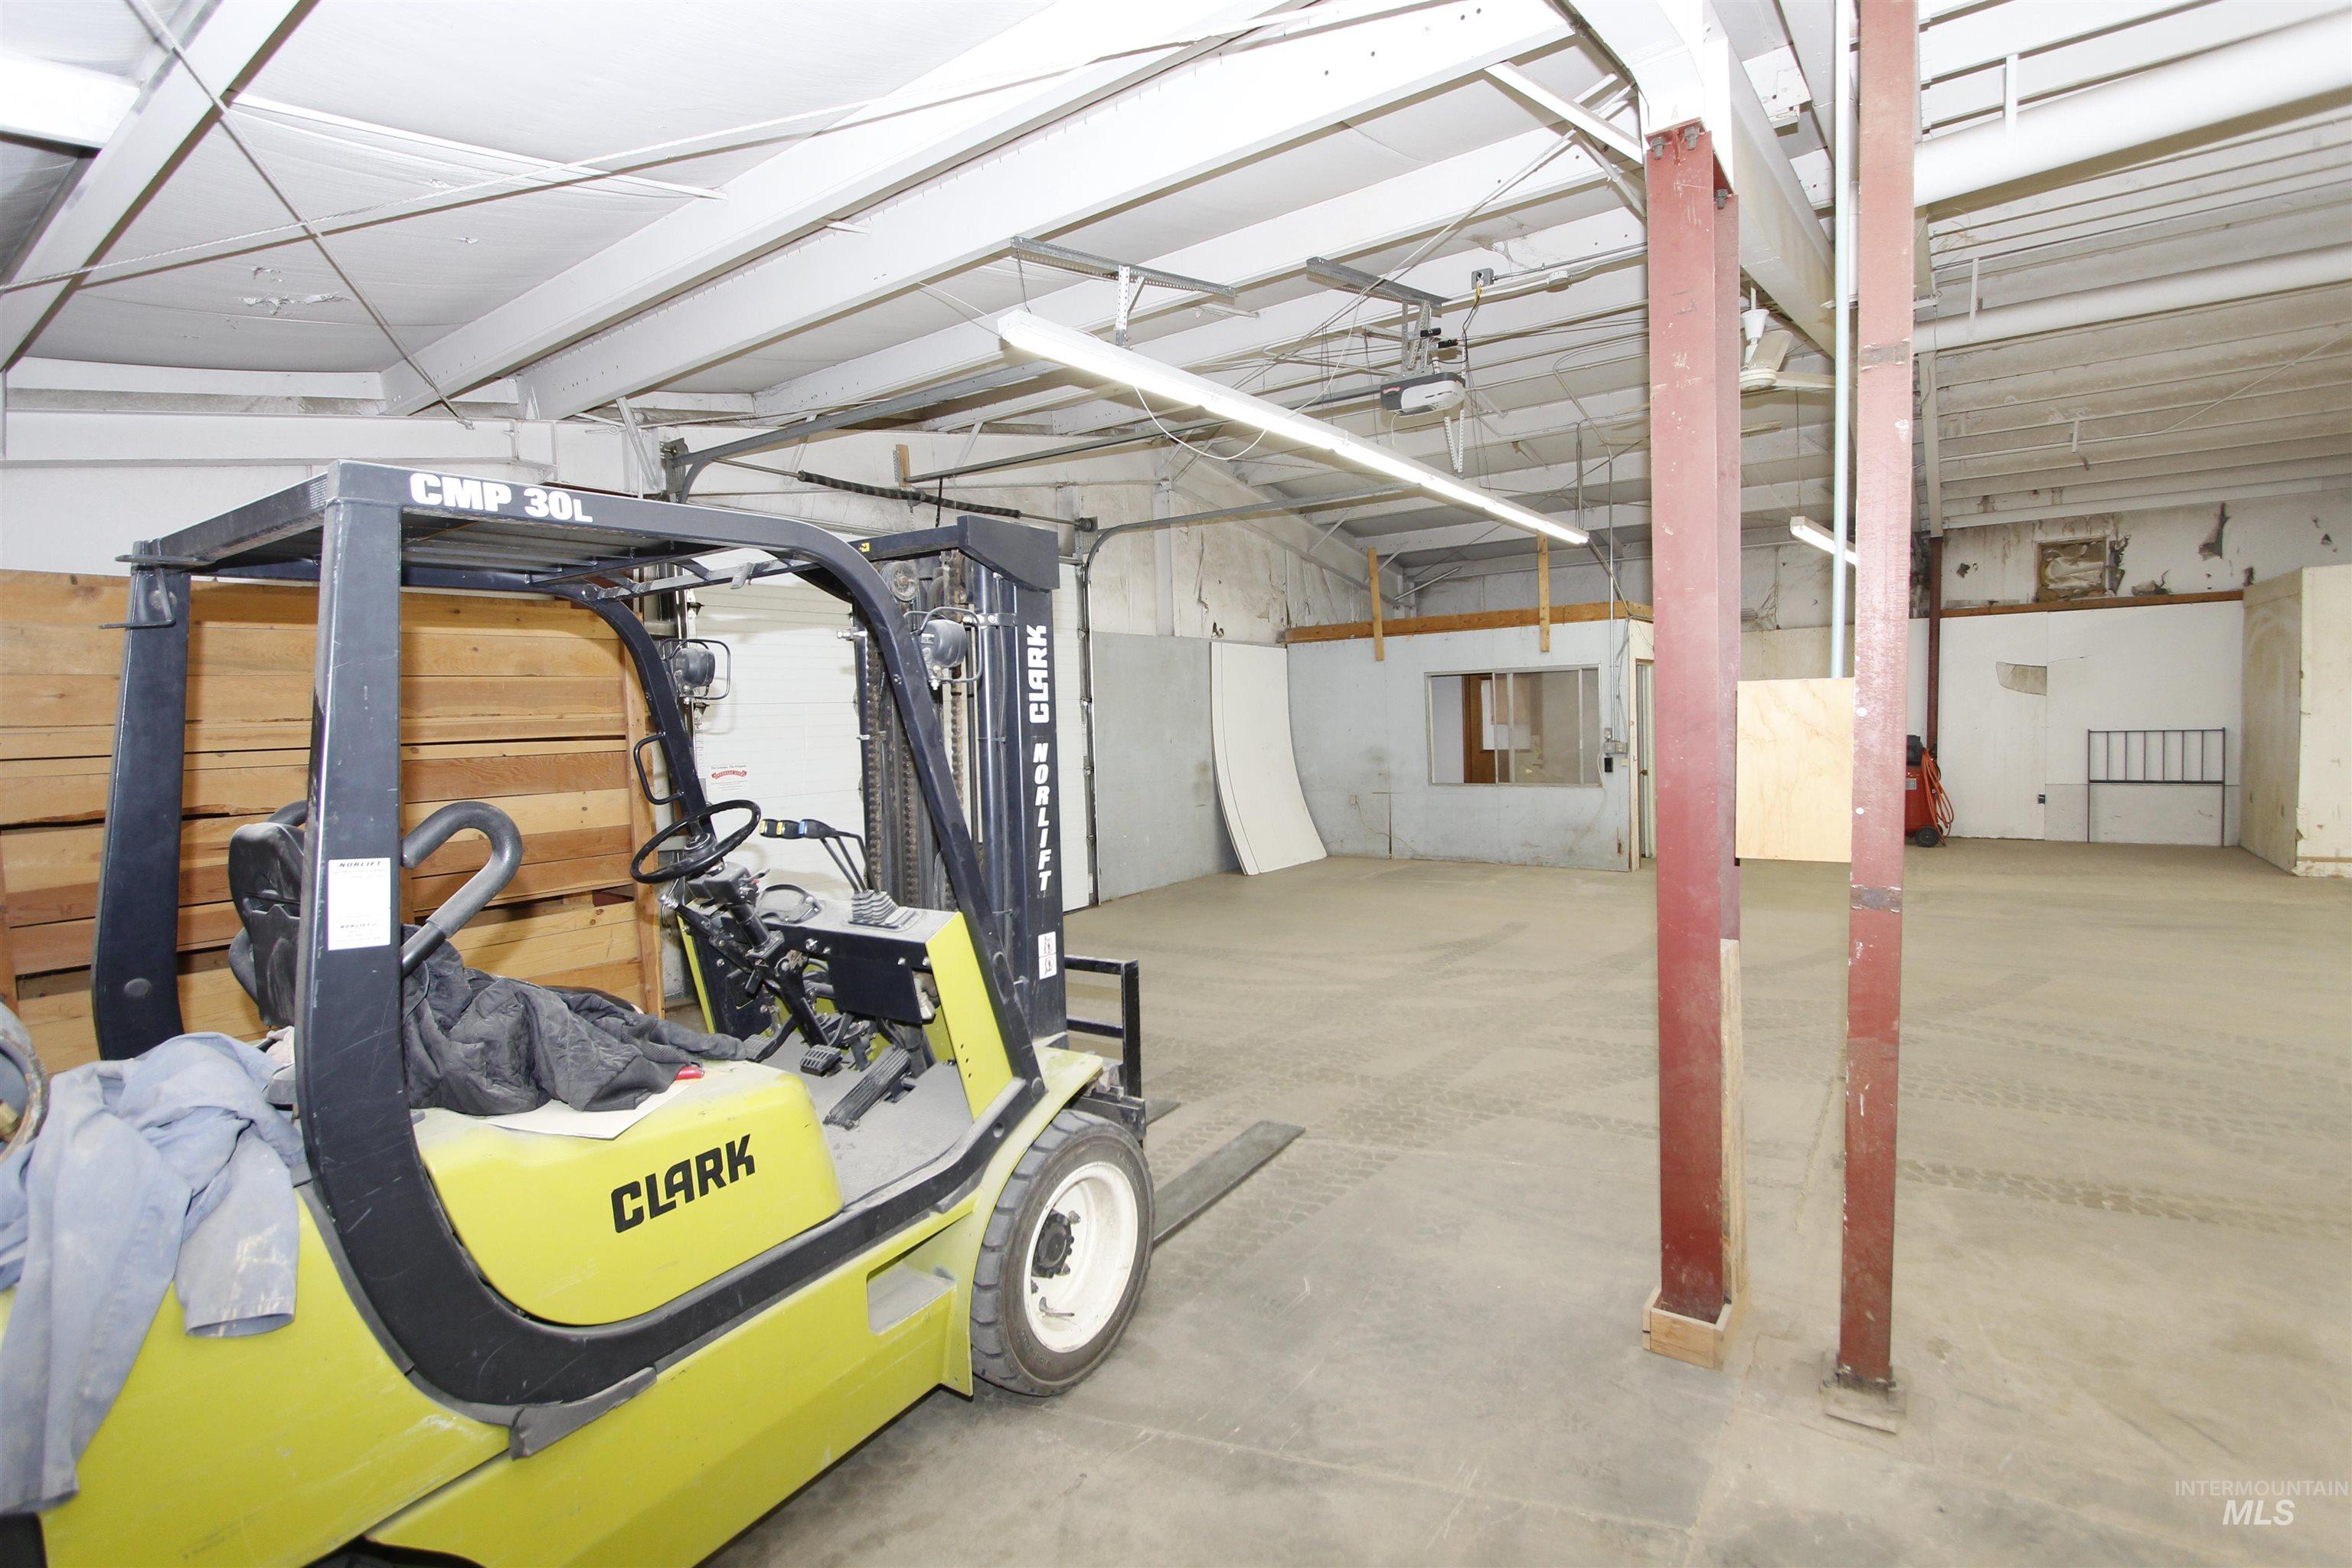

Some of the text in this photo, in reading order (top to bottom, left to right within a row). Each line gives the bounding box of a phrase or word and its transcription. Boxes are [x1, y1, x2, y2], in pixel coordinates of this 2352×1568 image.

[410, 472, 593, 523] CMP 30L
[1026, 624, 1050, 724] CLARK
[1033, 743, 1052, 892] NORLIFT
[611, 1133, 755, 1233] CLARK
